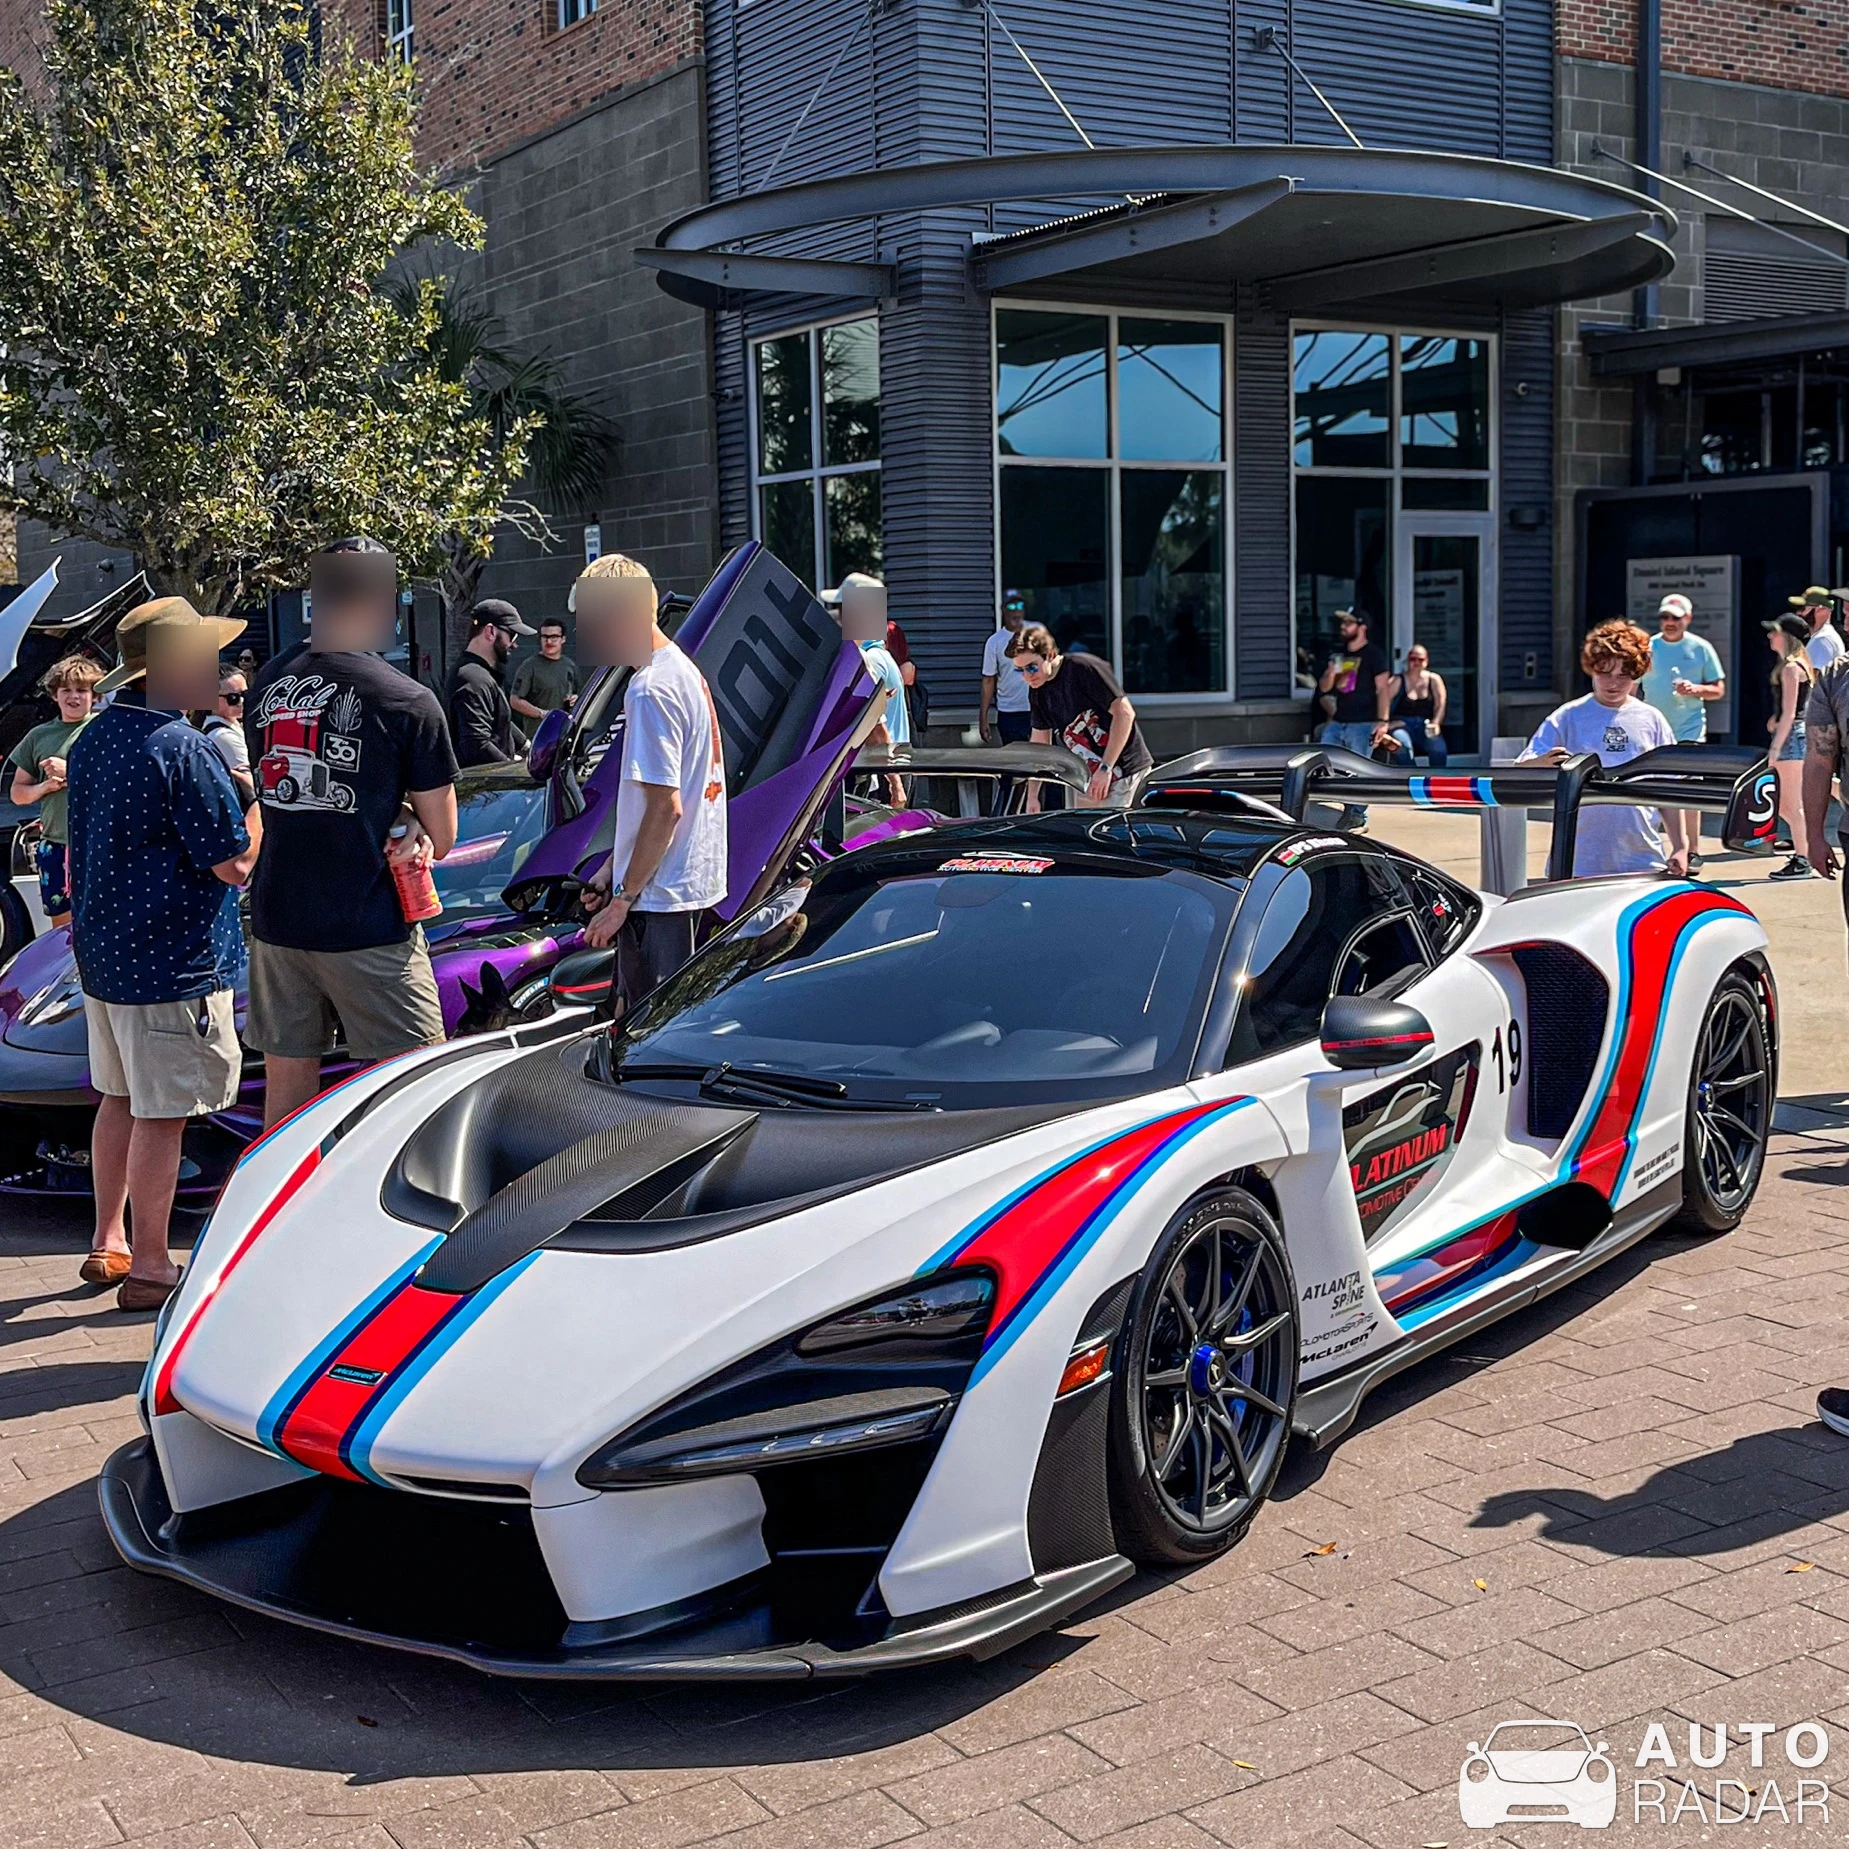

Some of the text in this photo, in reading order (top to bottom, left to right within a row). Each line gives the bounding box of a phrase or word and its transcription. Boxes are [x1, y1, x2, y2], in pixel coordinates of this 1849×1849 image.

[1664, 565, 1690, 576] Island
[1693, 564, 1724, 577] Square
[939, 859, 1055, 869] PLATINUM
[1002, 866, 1044, 874] CENTER
[1492, 1018, 1522, 1095] 19
[1302, 1271, 1360, 1301] ATLANTA
[1332, 1285, 1365, 1310] SPINE
[1299, 1332, 1369, 1365] McLaren
